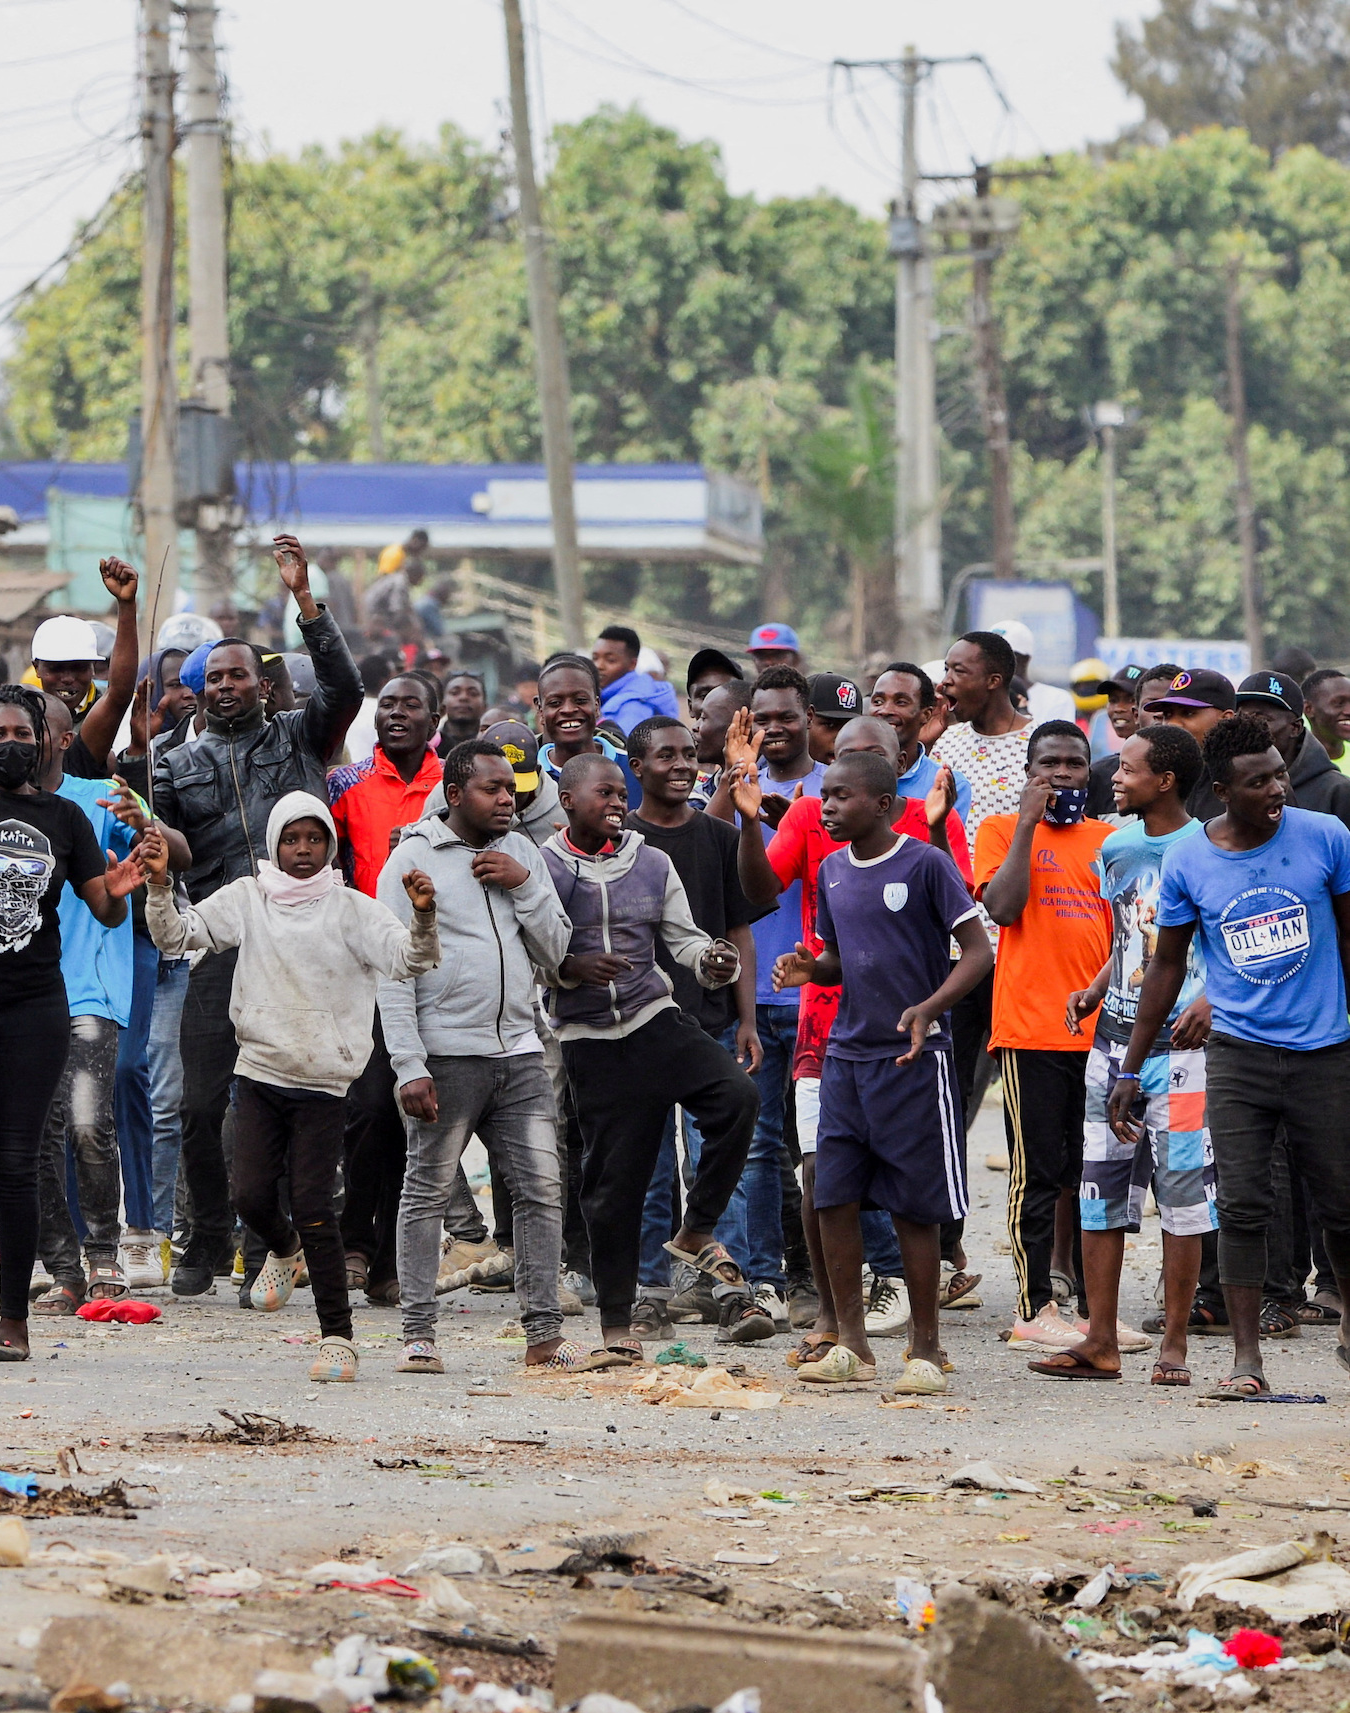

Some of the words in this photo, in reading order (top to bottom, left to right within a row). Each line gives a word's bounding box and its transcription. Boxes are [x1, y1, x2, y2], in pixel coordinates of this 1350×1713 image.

[1268, 676, 1283, 696] LA
[1231, 931, 1263, 951] OIL
[1269, 919, 1302, 943] MAN
